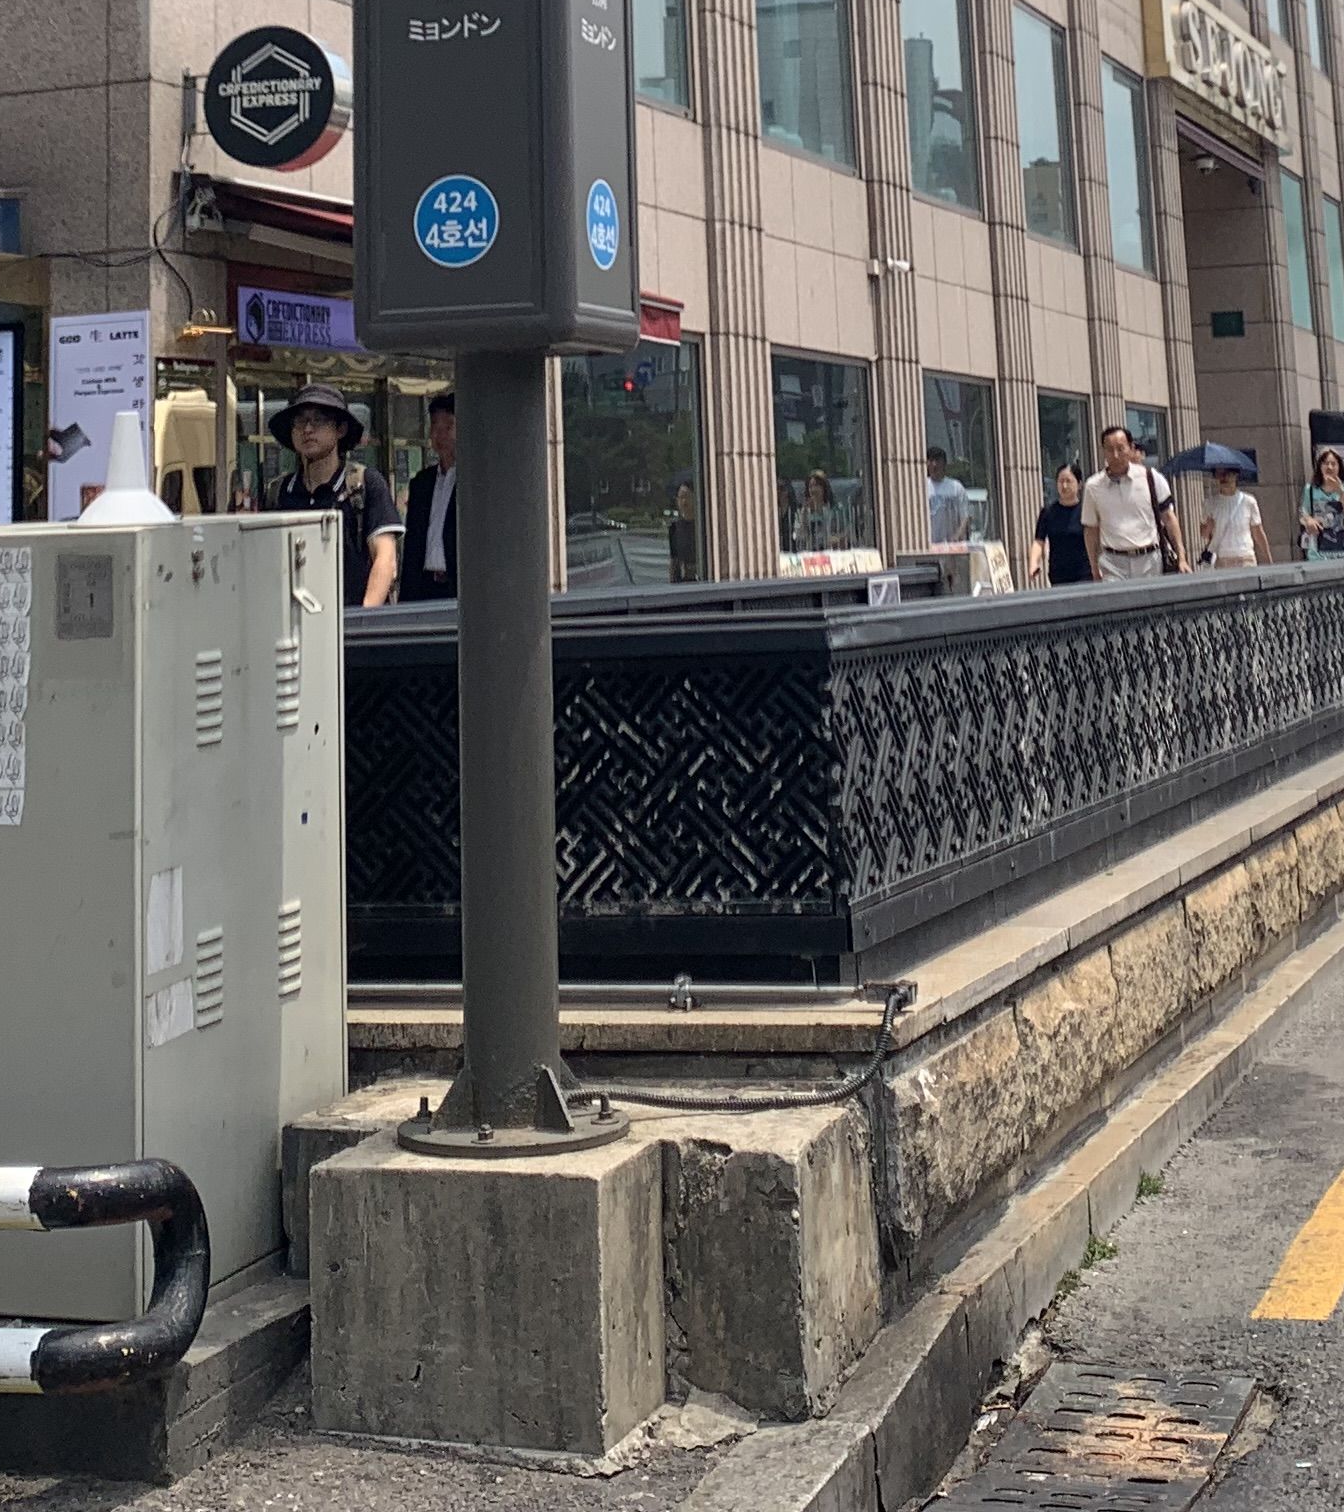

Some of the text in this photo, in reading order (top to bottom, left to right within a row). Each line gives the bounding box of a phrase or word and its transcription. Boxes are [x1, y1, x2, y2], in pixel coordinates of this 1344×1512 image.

[408, 11, 502, 42] ミョンドン
[241, 92, 299, 109] EXPRESS
[433, 190, 479, 215] 424
[593, 193, 612, 218] 424
[425, 216, 489, 250] 4호선
[591, 222, 616, 255] 4호선
